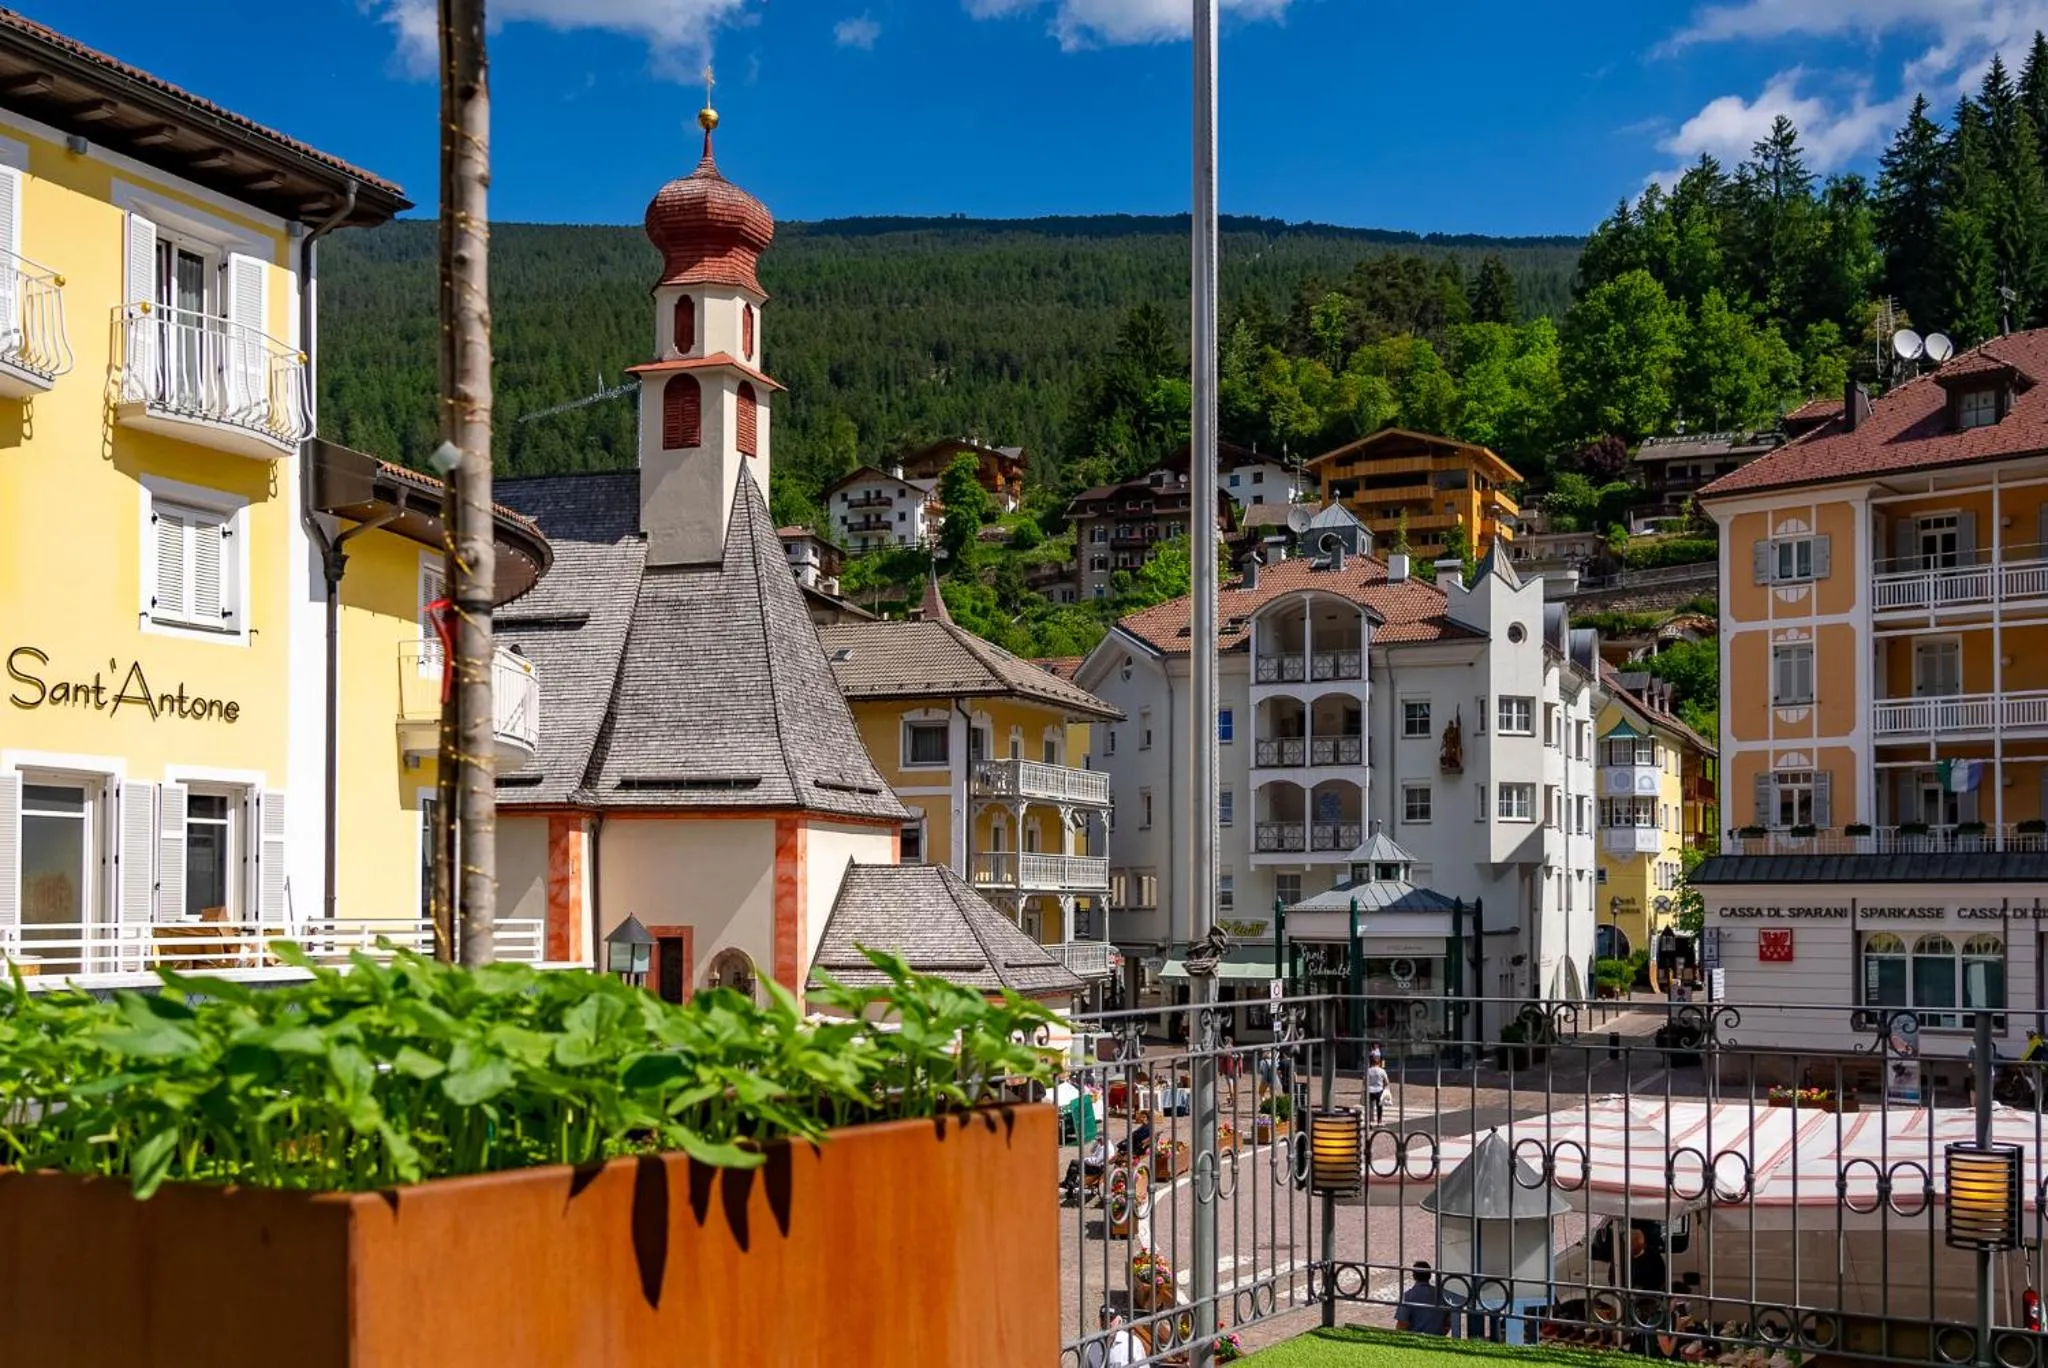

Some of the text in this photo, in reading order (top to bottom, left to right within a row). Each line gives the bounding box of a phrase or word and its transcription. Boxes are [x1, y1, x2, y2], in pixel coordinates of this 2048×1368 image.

[6, 646, 240, 724] Sant'Antone
[1719, 907, 1762, 919] CASSA
[1860, 907, 1945, 919] SPARKASSE
[1957, 907, 2009, 920] CASSA
[2013, 907, 2027, 920] DI
